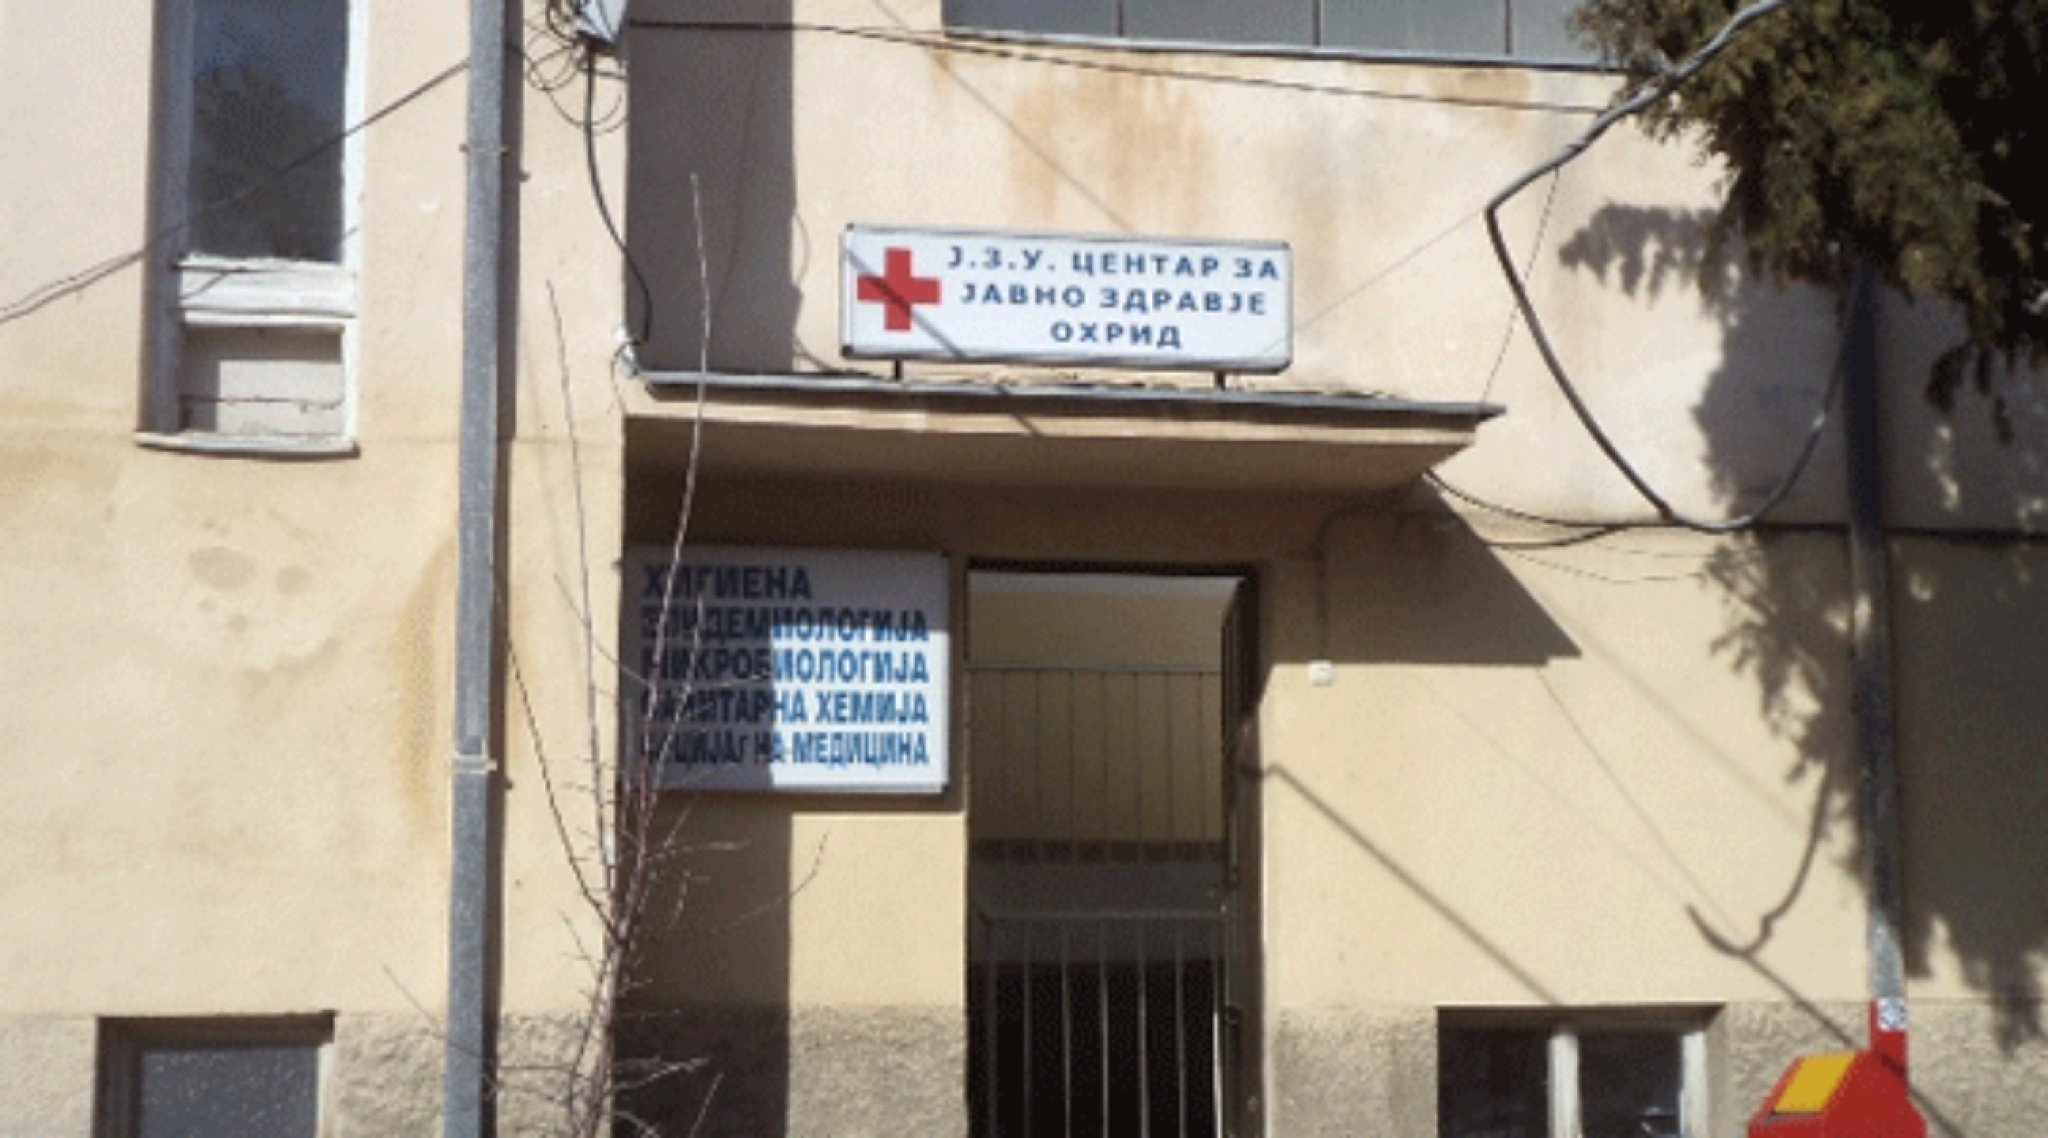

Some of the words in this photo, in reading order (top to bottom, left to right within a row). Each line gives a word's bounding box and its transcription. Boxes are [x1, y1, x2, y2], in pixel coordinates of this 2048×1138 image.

[1072, 250, 1219, 277] ЦЕНТАР
[1234, 257, 1279, 280] ЗА
[959, 284, 1086, 308] ЈАВНО
[1099, 288, 1267, 315] ЗДРАВЈЕ
[1050, 322, 1182, 349] ОХРИД
[644, 565, 812, 599] ХИГИЕНА
[815, 690, 930, 723] ХЕМИЈА
[792, 732, 930, 769] МЕДИЦИНА
